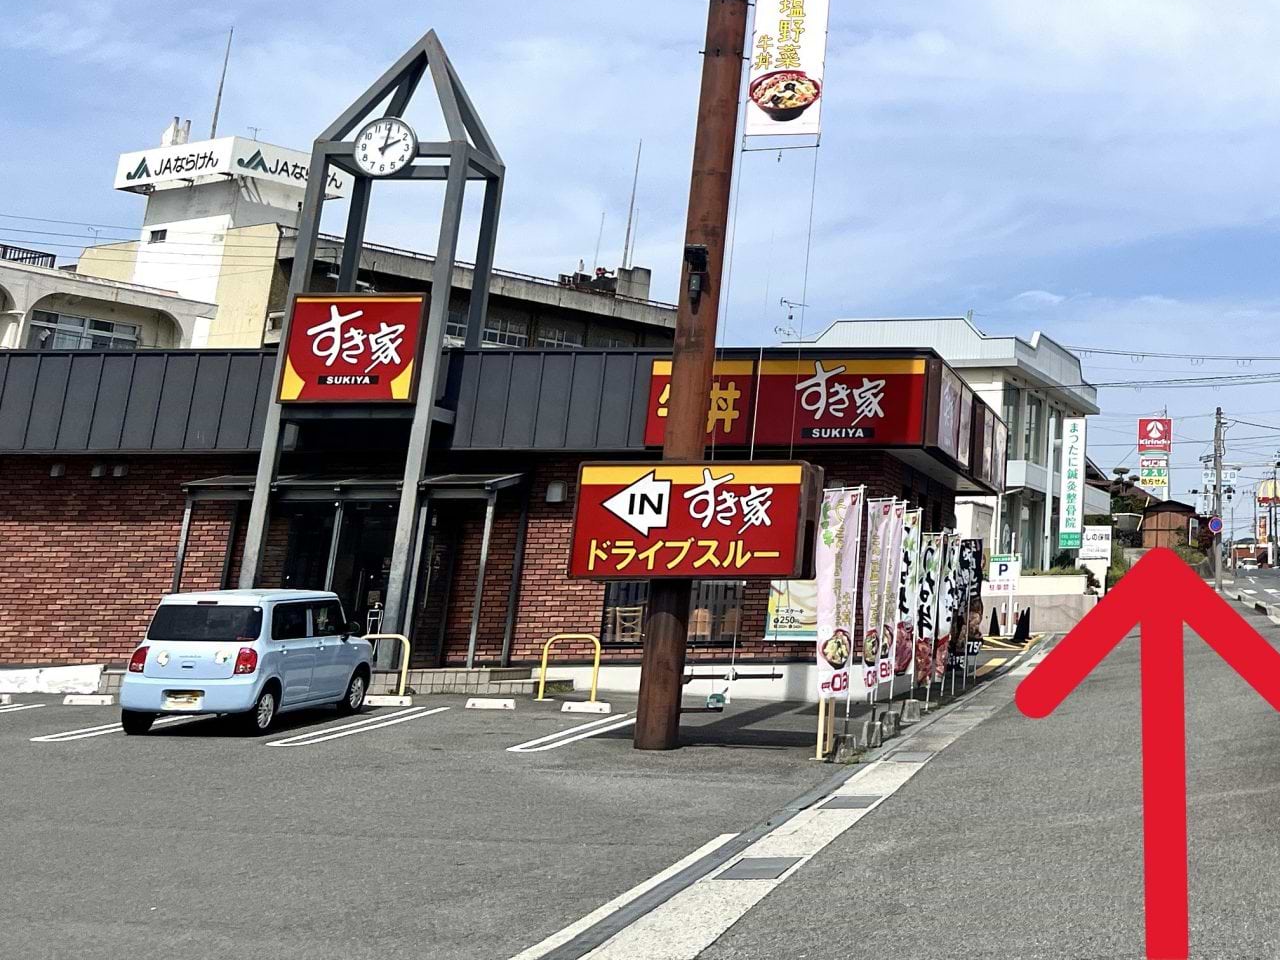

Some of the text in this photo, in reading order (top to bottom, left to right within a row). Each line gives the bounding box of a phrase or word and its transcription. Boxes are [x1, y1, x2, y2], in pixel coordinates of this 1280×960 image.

[754, 34, 774, 70] 牛丼
[402, 133, 408, 141] 2
[361, 143, 367, 151] 9
[404, 143, 410, 152] 3
[362, 154, 368, 162] 8
[154, 150, 219, 177] JAならけん
[370, 161, 376, 169] 7
[379, 163, 385, 172] 6
[390, 161, 396, 169] 5
[307, 304, 406, 374] すき家
[326, 376, 370, 384] SUKIYA
[795, 360, 886, 427] すき家
[811, 428, 864, 438] SUKIYA
[628, 493, 664, 515] IN
[682, 468, 774, 534] すき家
[588, 537, 780, 571] ドライブスルー
[999, 564, 1008, 576] P
